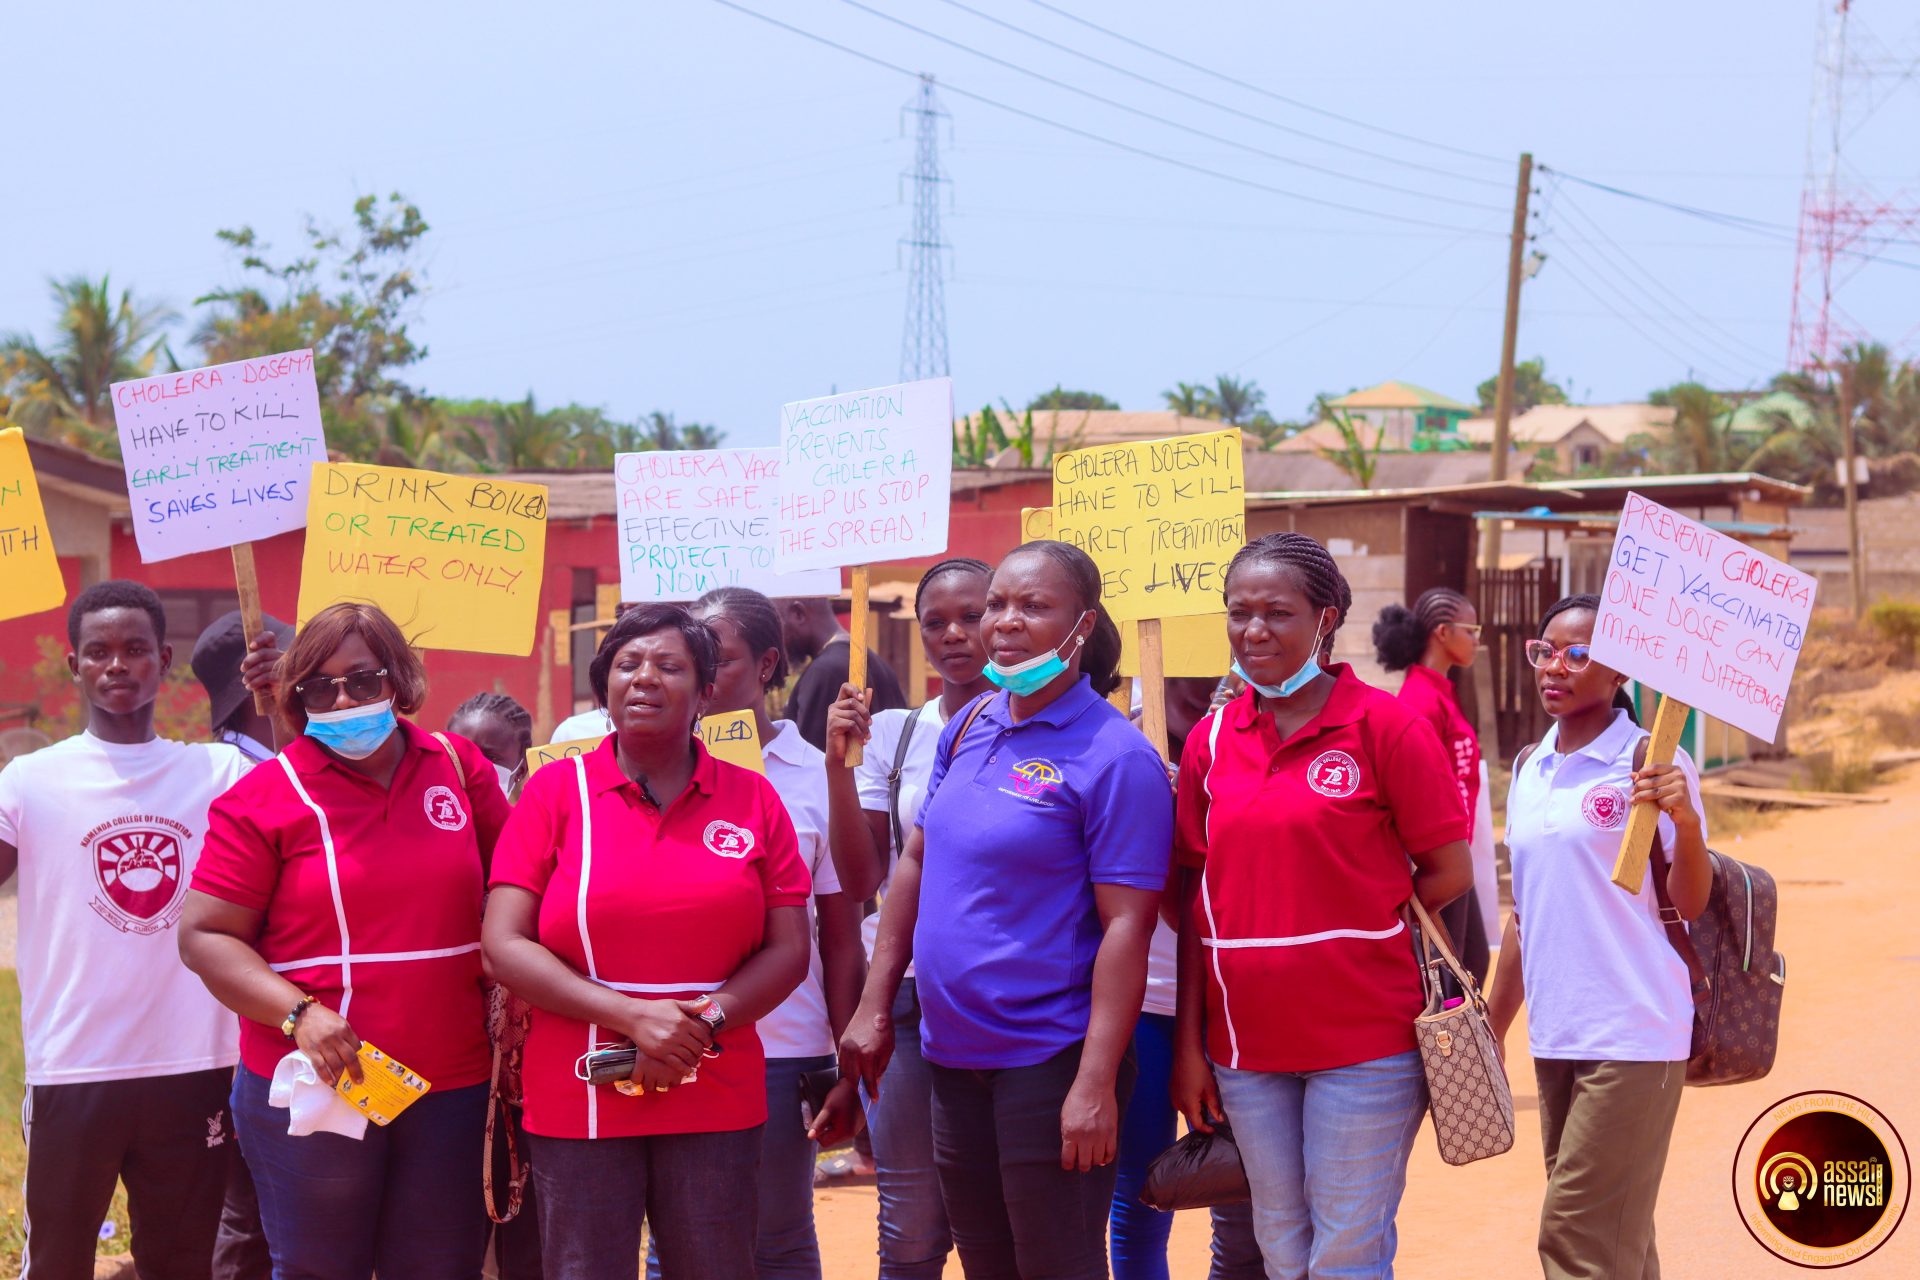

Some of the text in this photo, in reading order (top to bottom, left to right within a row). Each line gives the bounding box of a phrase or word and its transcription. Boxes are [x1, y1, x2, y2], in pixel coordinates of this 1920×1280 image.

[118, 370, 223, 408] CHOLERA
[131, 403, 299, 449] HAVE TO KILL
[784, 391, 903, 432] VACCINATION
[132, 437, 317, 488] EARLY TREATMENT
[786, 428, 889, 465] PREVENTS
[1055, 435, 1234, 484] CHOLERA DOESN'T
[616, 452, 781, 485] CHOLERA VACC
[812, 449, 919, 487] CHOLERA
[149, 480, 297, 523] SAVES LIVES
[325, 468, 547, 521] DRINK BOILED
[623, 486, 682, 513] ARE
[780, 474, 930, 520] HELP US STOP
[1058, 475, 1242, 518] HAVE TO KILL
[325, 512, 525, 552] OR TREATED
[780, 527, 816, 556] THE
[1624, 495, 1810, 608] PREVENT CHOLERA
[329, 550, 431, 580] WATER
[630, 544, 731, 574] PROTECT
[1145, 560, 1233, 595] LIVES
[1616, 534, 1802, 651] GET VACCINATED
[1608, 569, 1786, 673] ONE DOSE CAN
[1601, 612, 1785, 716] MAKE A DIFFERENCE
[700, 719, 753, 745] ILED
[80, 814, 193, 848] KOMENDA COLLEGE OF EDUCATION
